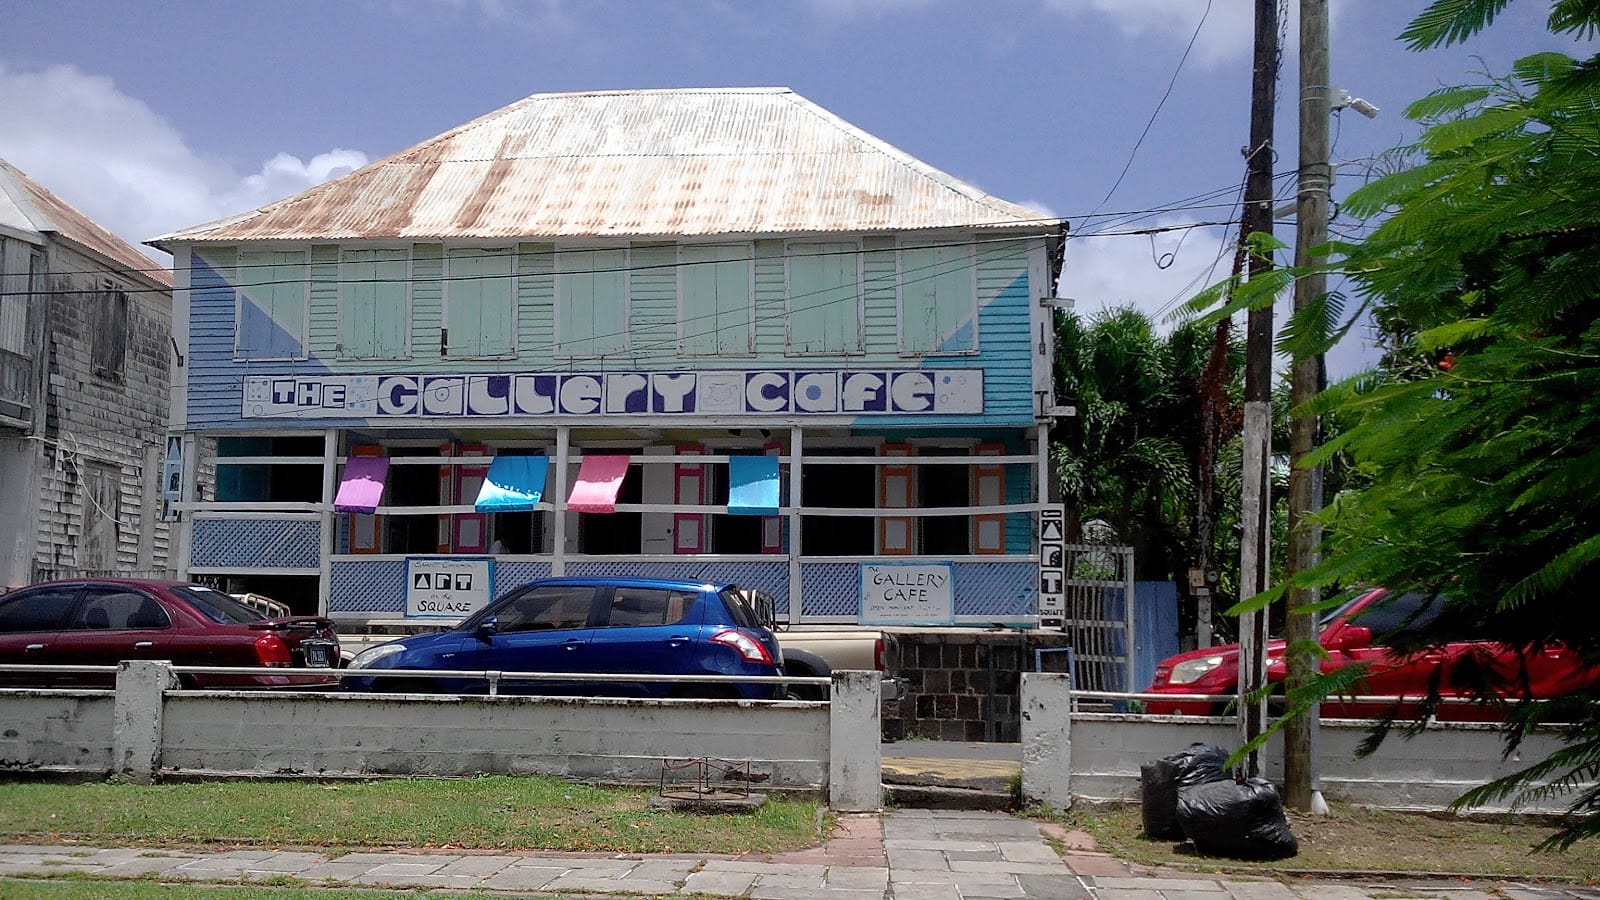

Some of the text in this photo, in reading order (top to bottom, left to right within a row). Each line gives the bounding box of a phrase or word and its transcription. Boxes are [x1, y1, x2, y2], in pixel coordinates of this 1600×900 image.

[273, 379, 346, 409] THE
[873, 573, 948, 589] GALLERY
[884, 588, 928, 602] CAFE
[417, 600, 472, 612] SQUARE
